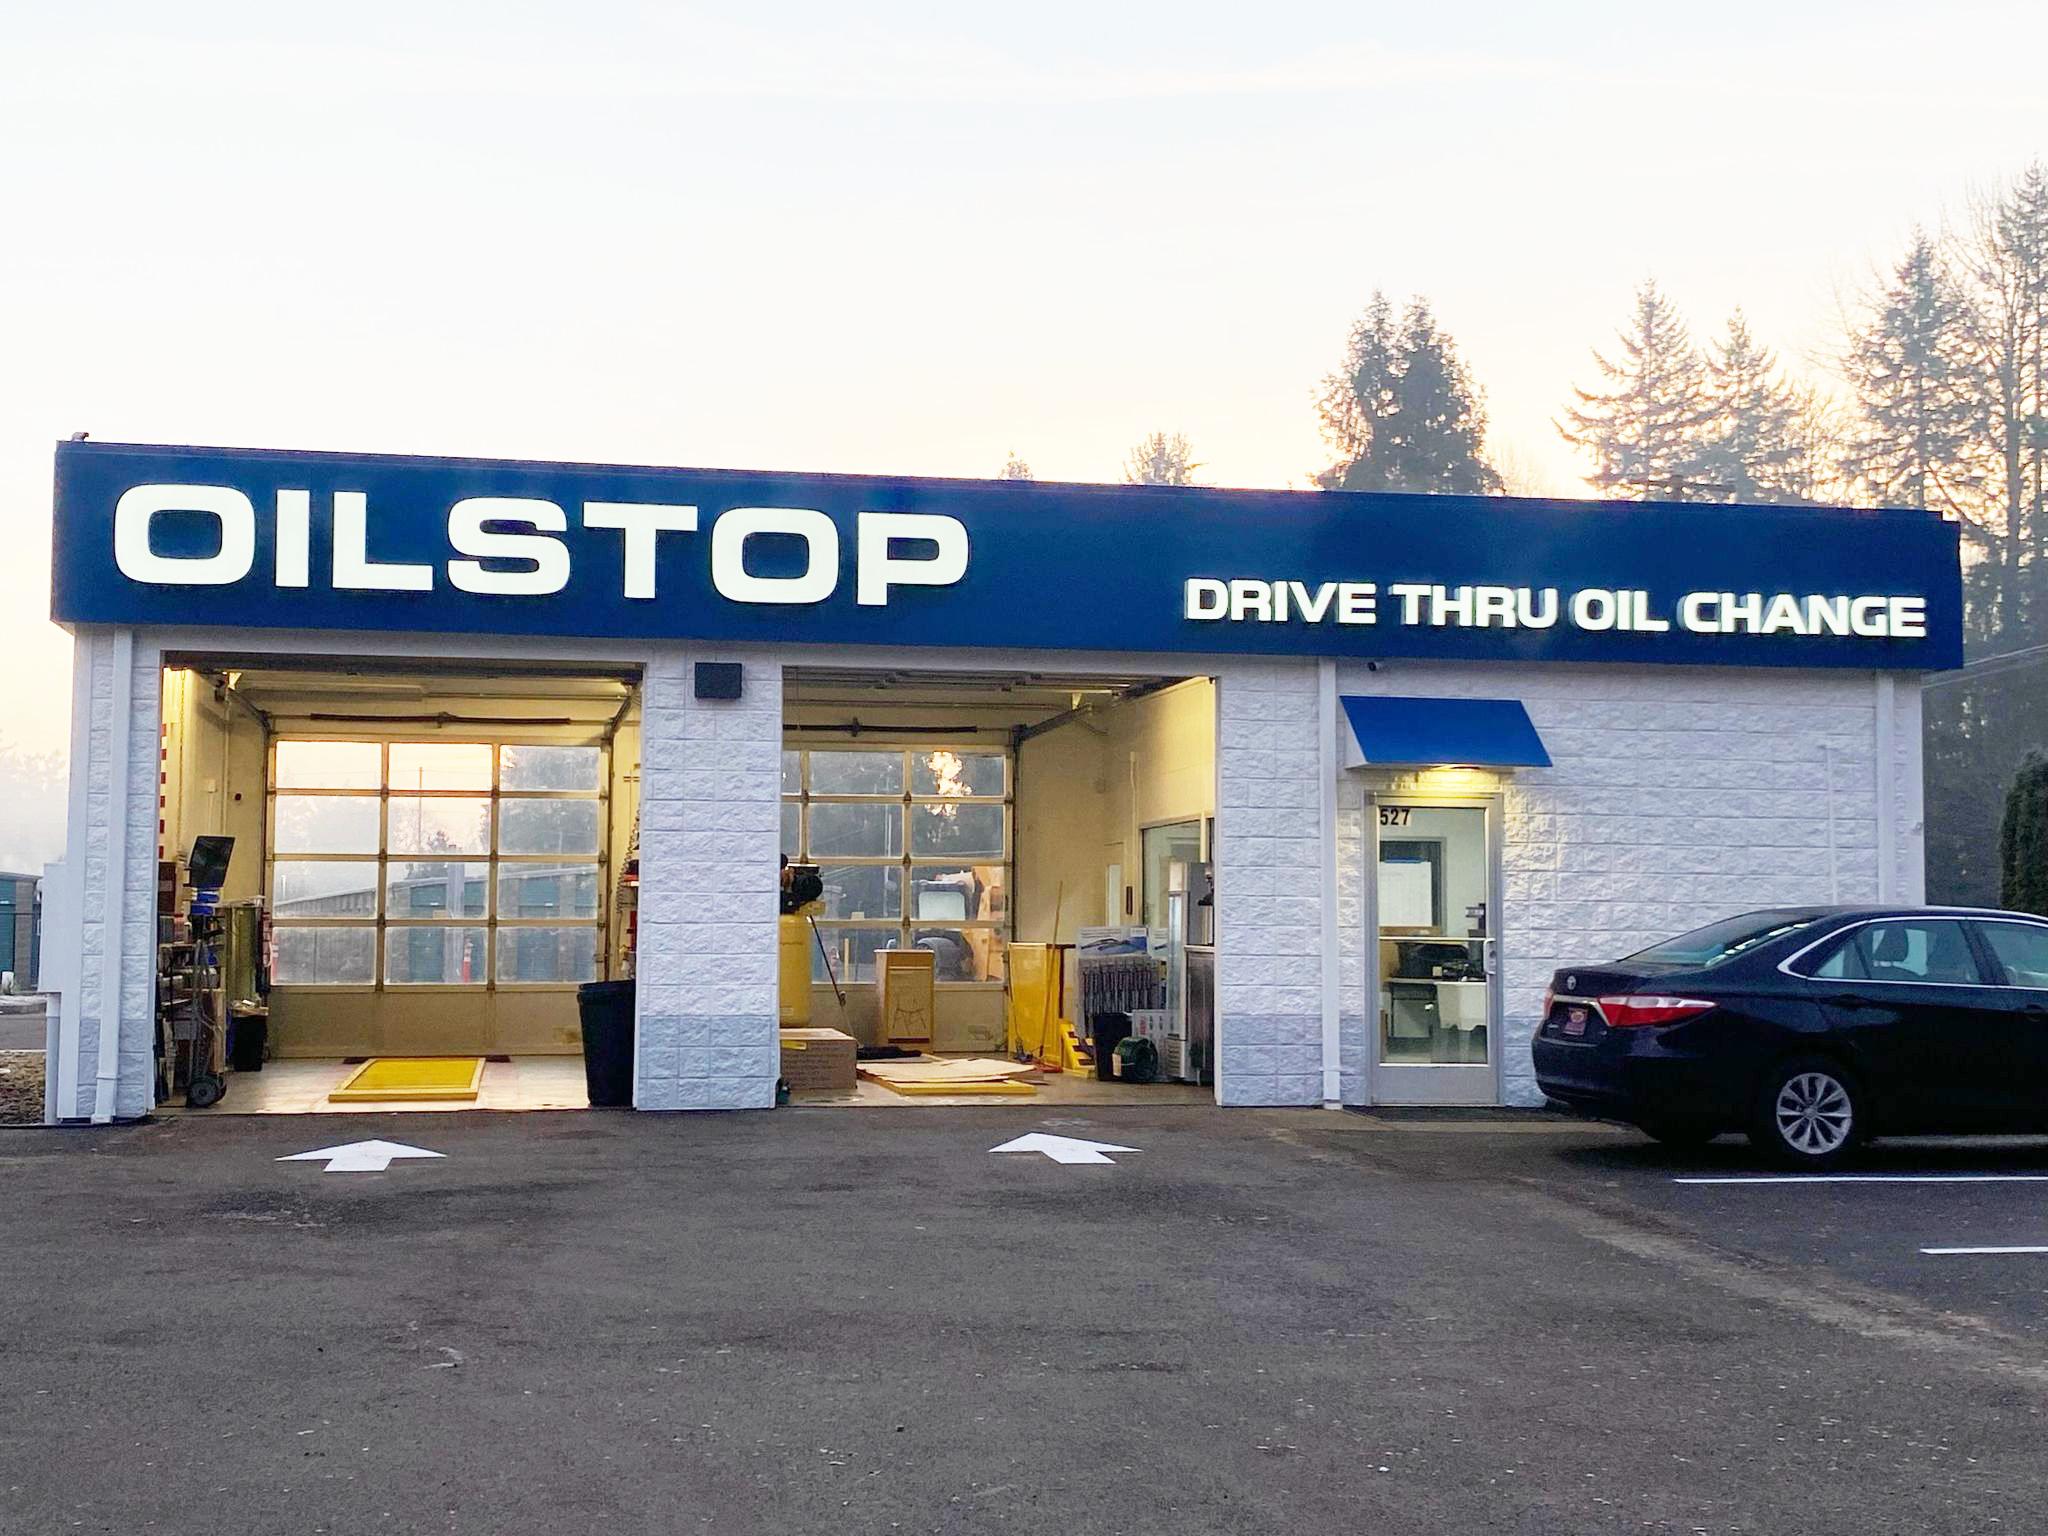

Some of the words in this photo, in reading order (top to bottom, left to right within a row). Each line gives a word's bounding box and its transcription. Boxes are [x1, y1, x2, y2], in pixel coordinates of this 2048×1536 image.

[114, 483, 969, 607] OILSTOP
[1185, 578, 1378, 625] DRIVE
[1389, 584, 1559, 630] THRU
[1570, 588, 1670, 633] OIL
[1677, 592, 1928, 638] CHANGE
[1380, 808, 1410, 826] 527
